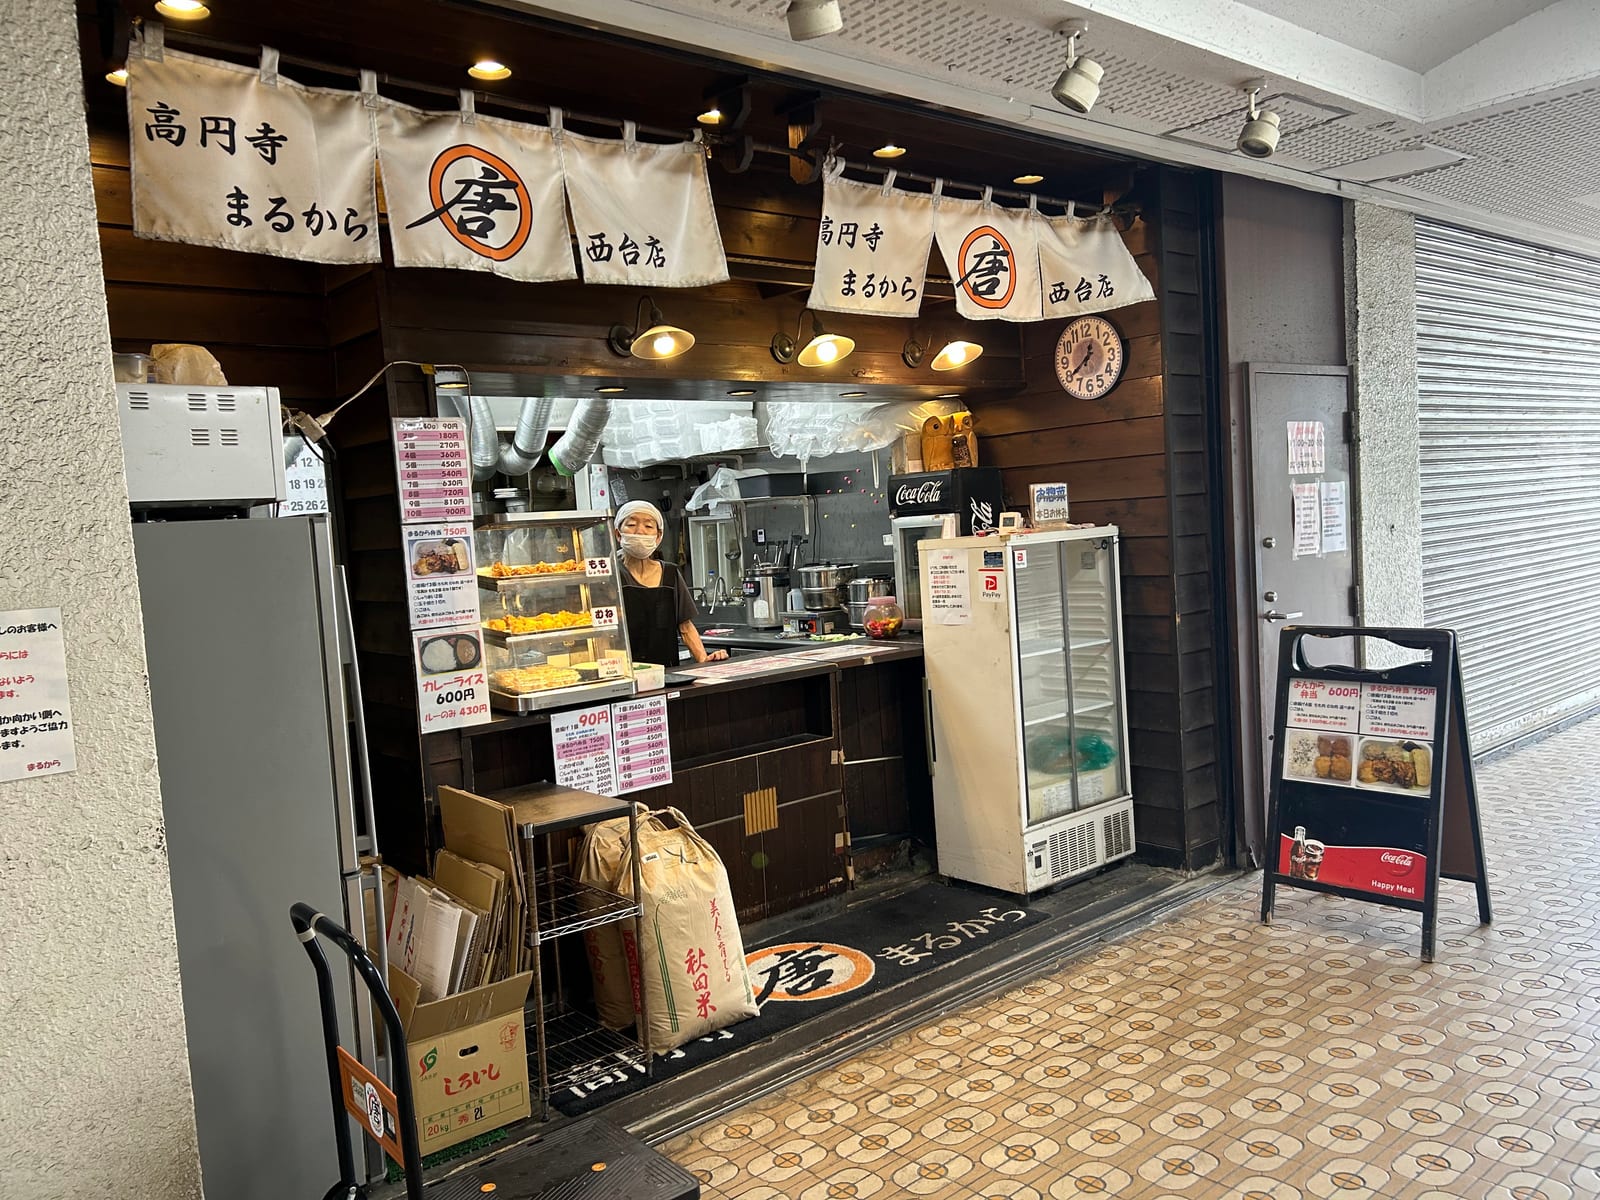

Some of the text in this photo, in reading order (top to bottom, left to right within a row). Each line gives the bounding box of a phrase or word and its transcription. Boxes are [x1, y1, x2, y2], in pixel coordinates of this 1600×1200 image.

[145, 101, 288, 165] 高円寺
[406, 166, 519, 239] 唐
[225, 186, 370, 242] まるから
[821, 215, 884, 252] 高円寺
[586, 232, 666, 269] 西台店
[956, 240, 1010, 297] 唐
[841, 269, 917, 301] まるから
[1048, 273, 1115, 304] 西台店
[1071, 329, 1078, 343] 11
[1080, 323, 1091, 338] 12
[1096, 325, 1100, 339] 1
[1103, 332, 1111, 346] 2
[1063, 340, 1072, 355] 10
[1108, 348, 1115, 361] 3
[1061, 356, 1069, 369] 9
[1105, 363, 1113, 376] 4
[1066, 370, 1073, 383] 8
[1096, 374, 1104, 388] 5
[1076, 377, 1083, 391] 7
[1086, 379, 1093, 392] 6
[301, 457, 313, 467] 12
[289, 479, 300, 489] 18
[303, 479, 315, 488] 19
[896, 480, 943, 505] Coca-Cola
[291, 501, 303, 511] 25
[305, 501, 318, 510] 26
[1037, 508, 1067, 519] 本日お休み
[588, 560, 607, 569] もも
[595, 609, 613, 619] むね
[423, 674, 484, 693] カレーライス
[1370, 685, 1408, 693] まるから弁当
[437, 688, 475, 705] 600円
[1301, 688, 1358, 698] 弁当 600円
[425, 704, 487, 722] ルーのみ 430円
[579, 710, 608, 727] 90円
[27, 760, 61, 771] まるから
[1381, 852, 1413, 866] Coca-Cola
[1371, 880, 1415, 894] Happy Meal
[875, 907, 1027, 966] まるから
[684, 948, 717, 1019] 秋田米
[443, 1063, 500, 1096] しろいし
[474, 1106, 485, 1120] 2L
[428, 1124, 449, 1137] 20kg
